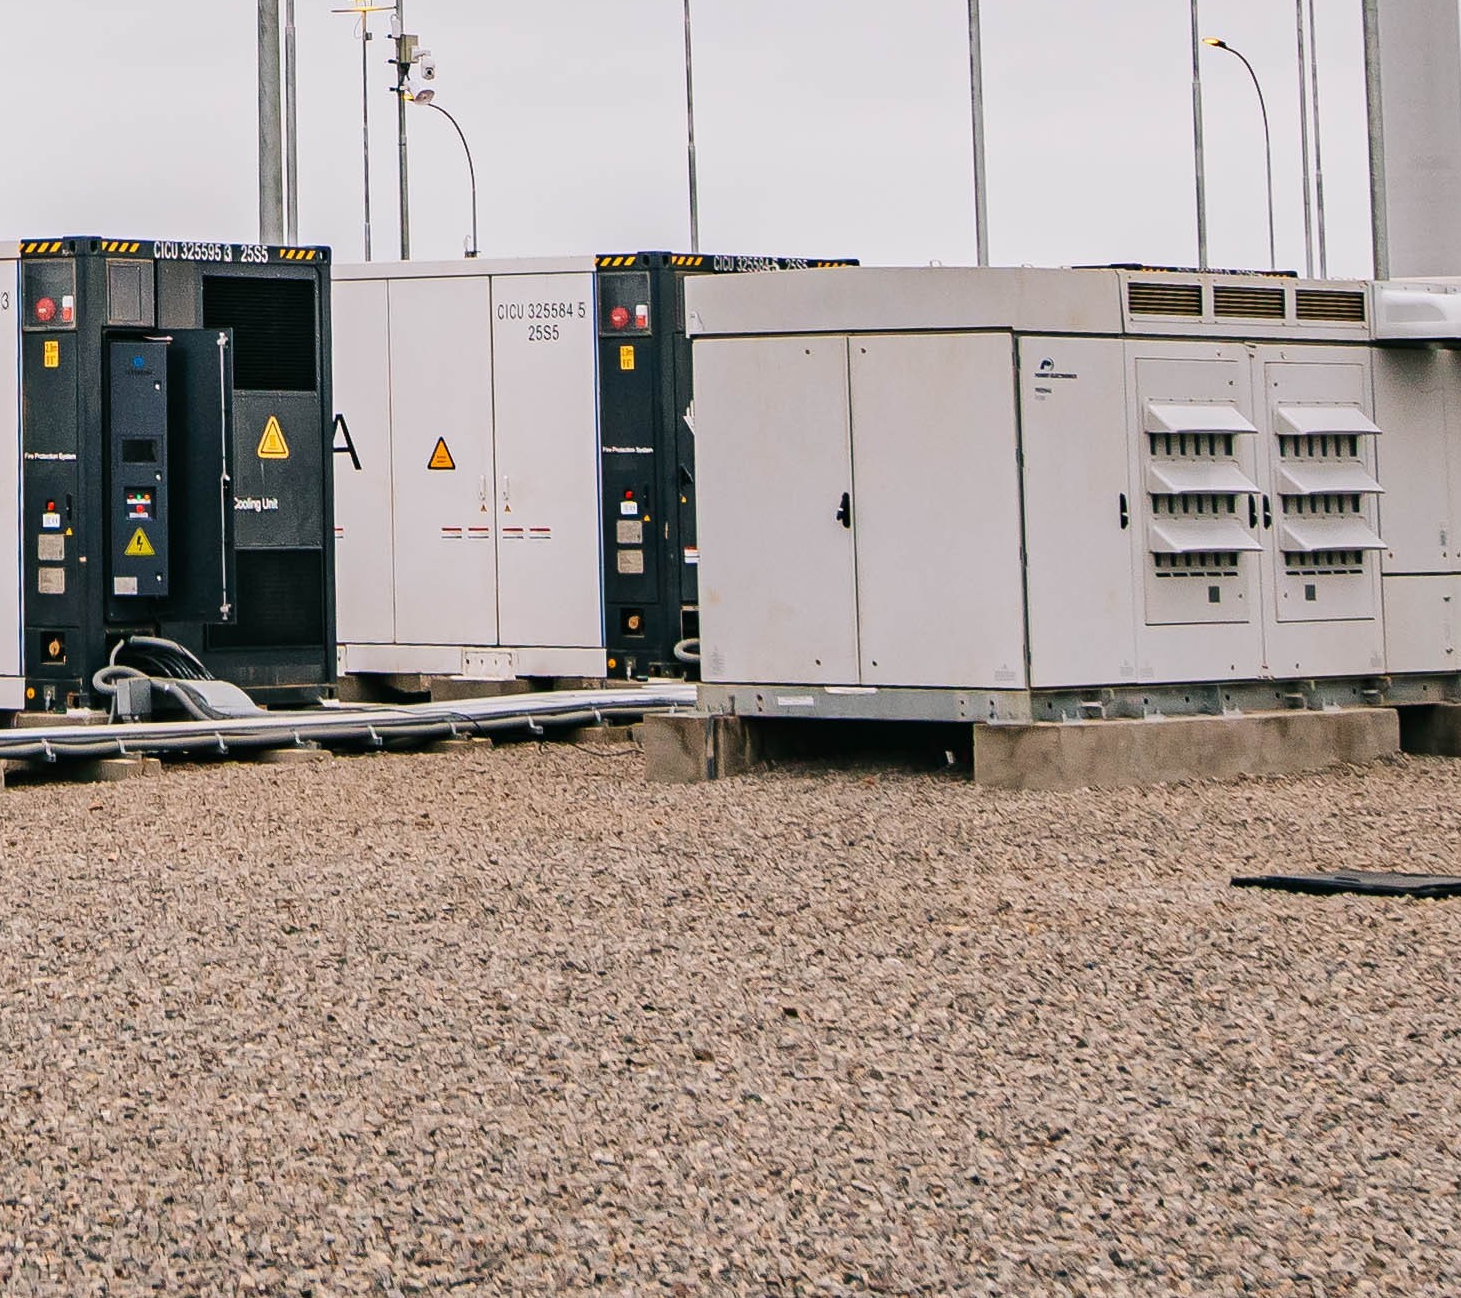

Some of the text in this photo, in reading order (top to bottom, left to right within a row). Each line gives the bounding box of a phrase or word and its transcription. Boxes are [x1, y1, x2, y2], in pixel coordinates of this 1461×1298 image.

[153, 241, 269, 263] CICU 325595 3 25S5
[1, 292, 9, 310] 3
[497, 302, 586, 320] CICU 325584 5
[528, 324, 560, 341] 25S5
[333, 414, 362, 470] A
